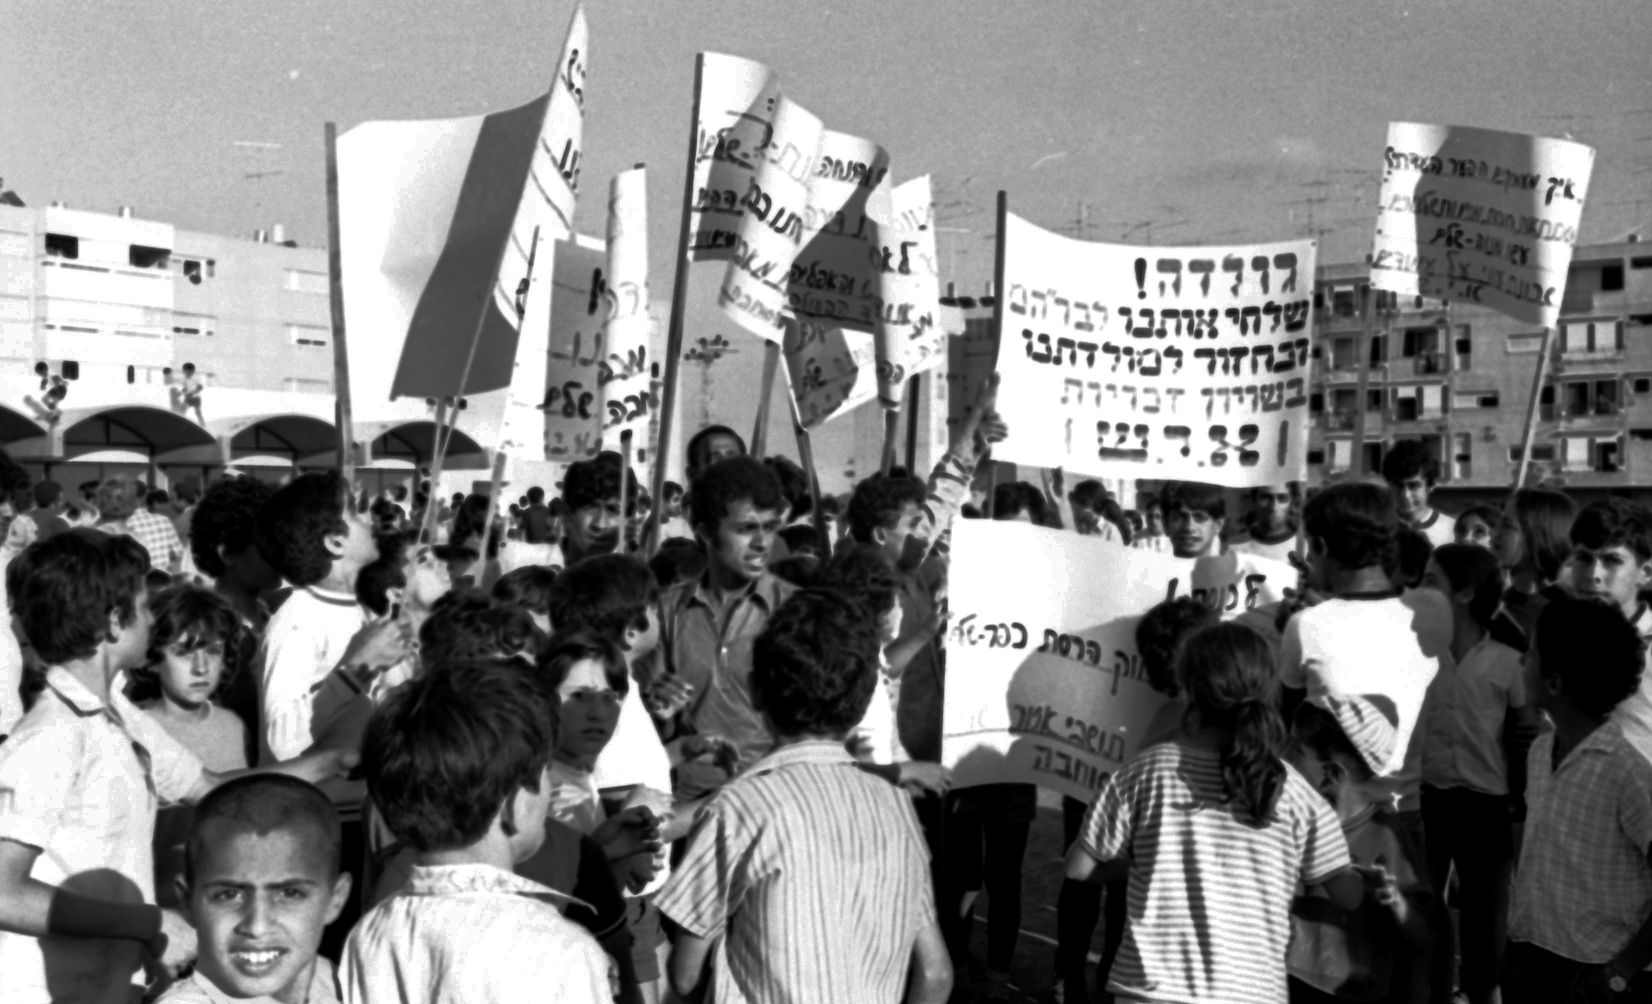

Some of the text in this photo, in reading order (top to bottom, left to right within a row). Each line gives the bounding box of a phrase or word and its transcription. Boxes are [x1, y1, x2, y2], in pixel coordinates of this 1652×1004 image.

[1134, 252, 1298, 299] גולדה!
[1117, 306, 1219, 339] אותנו
[1224, 299, 1310, 336] שלחי
[1021, 328, 1184, 377] למולדתנו
[1060, 377, 1186, 414] זכויות
[1037, 627, 1102, 667] הרסת
[1065, 715, 1126, 764] תושבי
